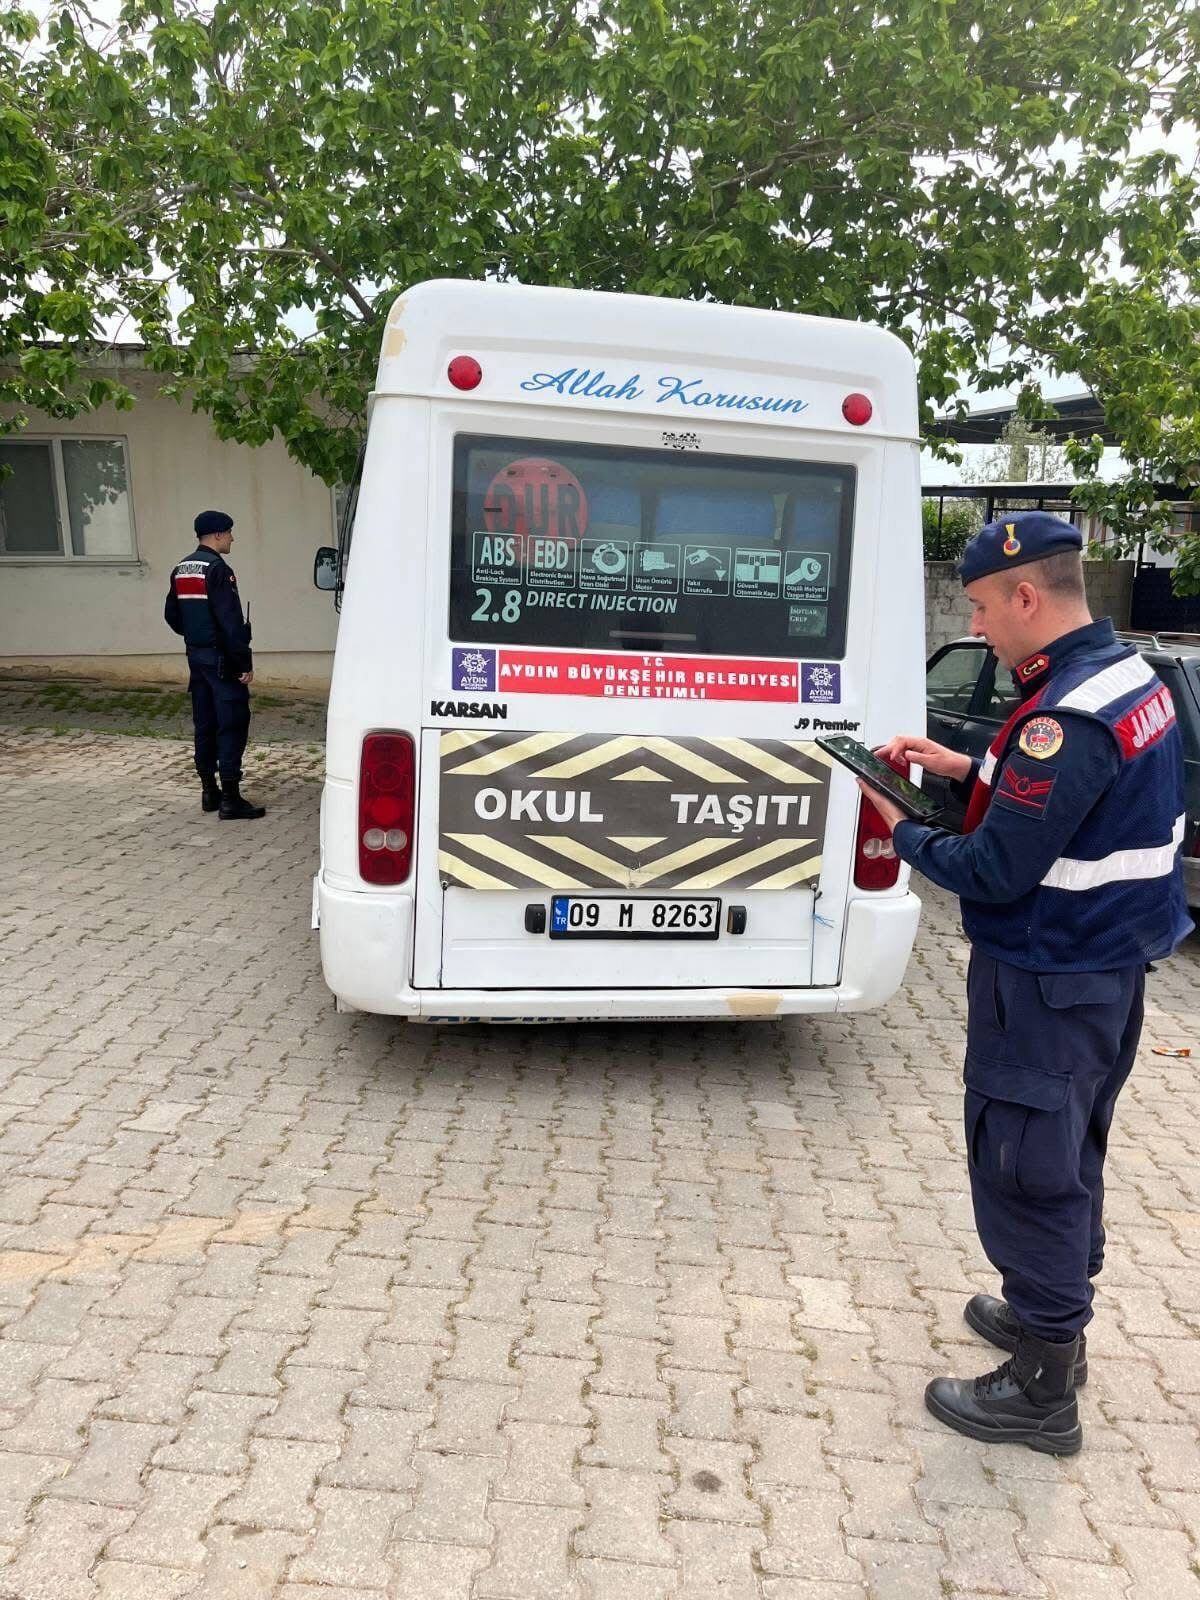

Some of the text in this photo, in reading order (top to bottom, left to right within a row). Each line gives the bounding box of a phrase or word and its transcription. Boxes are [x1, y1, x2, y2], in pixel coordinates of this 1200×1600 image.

[520, 368, 809, 414] Allah Korusun
[480, 536, 516, 566] ABS
[534, 540, 569, 569] EBD
[471, 588, 678, 623] 2.8 DIRECT INJECTION
[460, 676, 488, 684] AYDIN
[500, 663, 559, 678] AYDIN
[431, 700, 507, 719] KARSAN
[794, 717, 861, 731] J9 Premier
[474, 787, 811, 833] OKUL TAŞITI
[555, 916, 567, 925] TR
[570, 903, 713, 928] 09 M 8263
